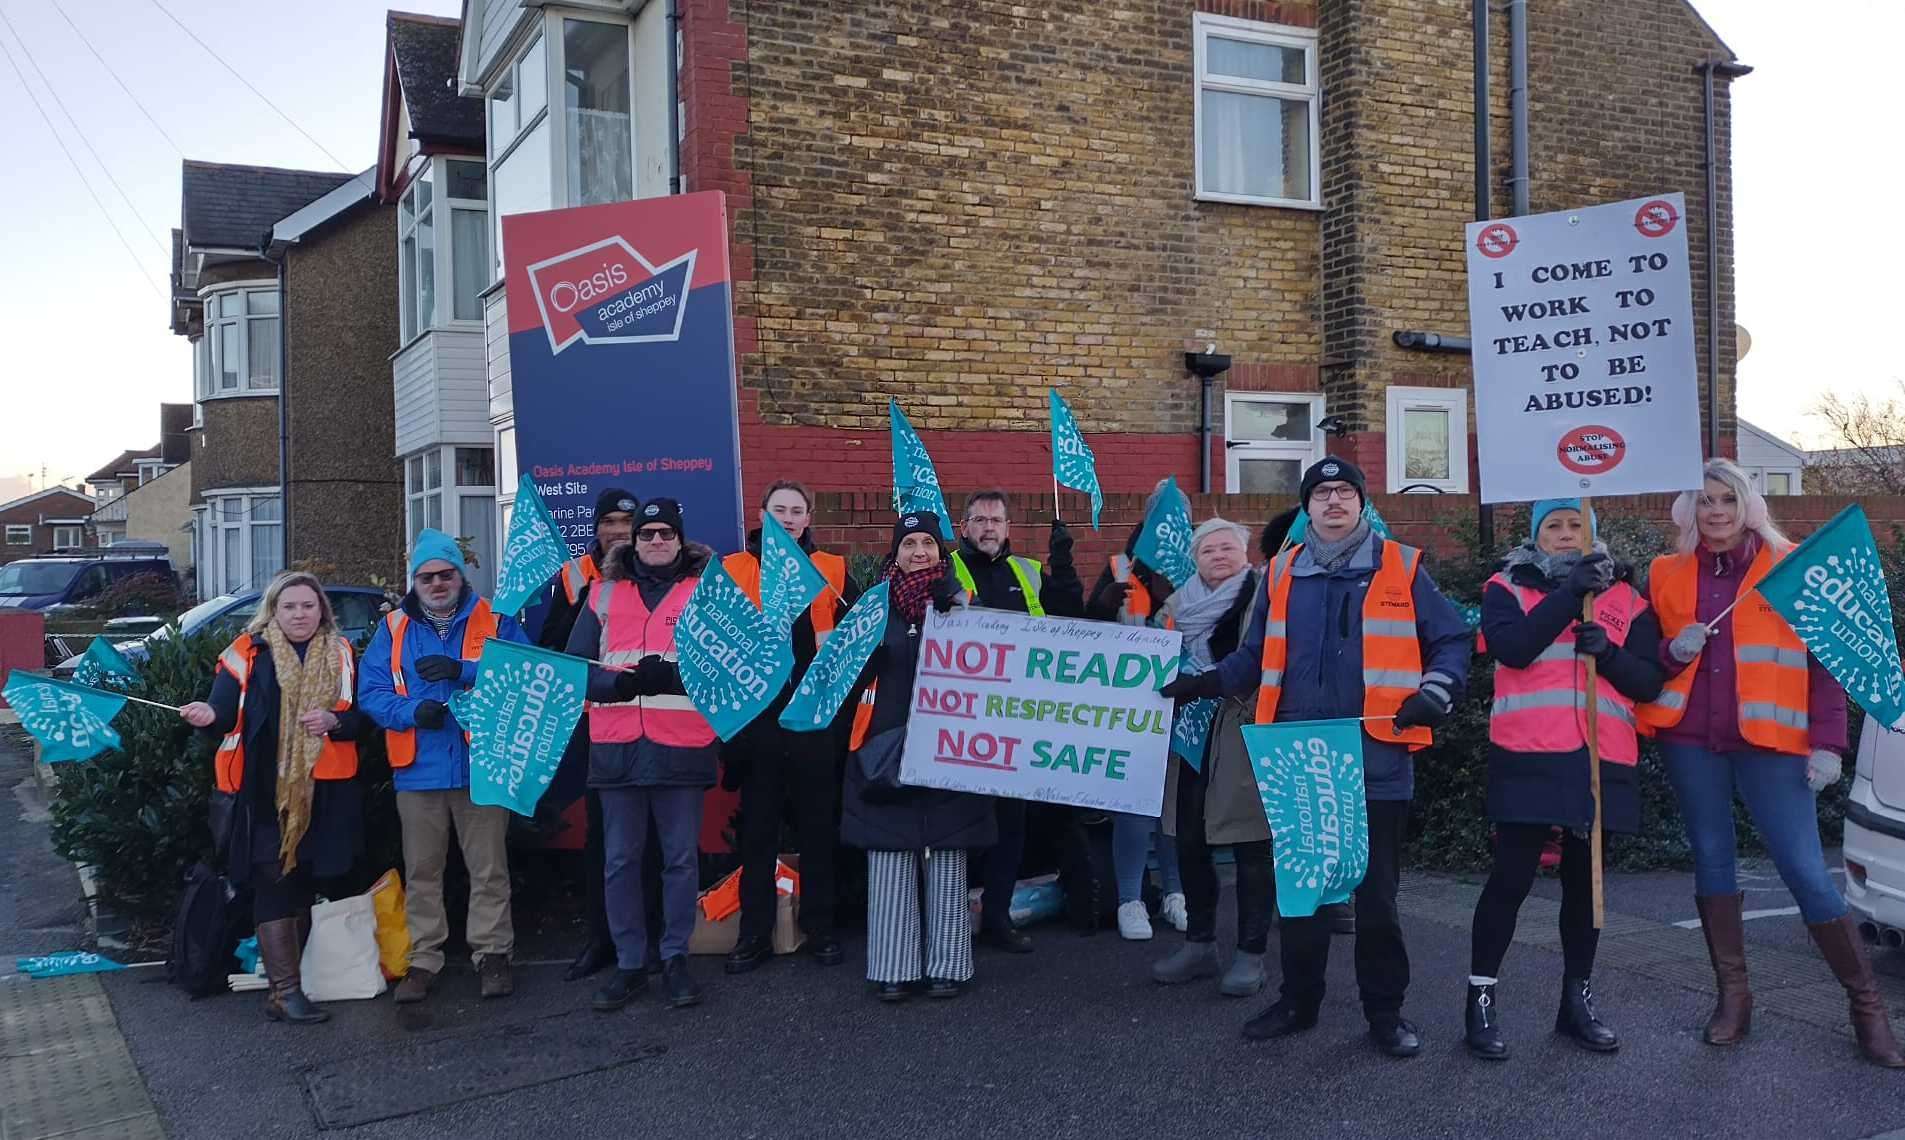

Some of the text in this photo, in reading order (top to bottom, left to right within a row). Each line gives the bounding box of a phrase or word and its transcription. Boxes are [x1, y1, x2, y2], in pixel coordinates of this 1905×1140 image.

[551, 263, 628, 312] Oasis
[1493, 252, 1669, 289] I COME TO
[597, 280, 665, 321] academy
[606, 294, 677, 333] isle of sheppey
[1501, 288, 1655, 323] WORK TO
[1493, 318, 1672, 356] TEACH, NOT
[1541, 355, 1646, 383] TO BE
[1523, 386, 1653, 413] ABUSED!
[1560, 442, 1626, 454] NORMALISING
[1579, 433, 1604, 442] STOP
[533, 457, 713, 479] Oasis Academy Isle of Sheppey
[1577, 453, 1608, 462] ABUSE
[534, 481, 588, 497] West Site
[570, 524, 594, 537] 2BE
[703, 600, 762, 656] national
[1830, 619, 1883, 669] union
[685, 639, 720, 683] union
[924, 639, 1181, 692] NOT READY
[917, 687, 979, 714] NOT
[984, 693, 1167, 735] RESPECTFUL
[937, 728, 1131, 781] NOT SAFE
